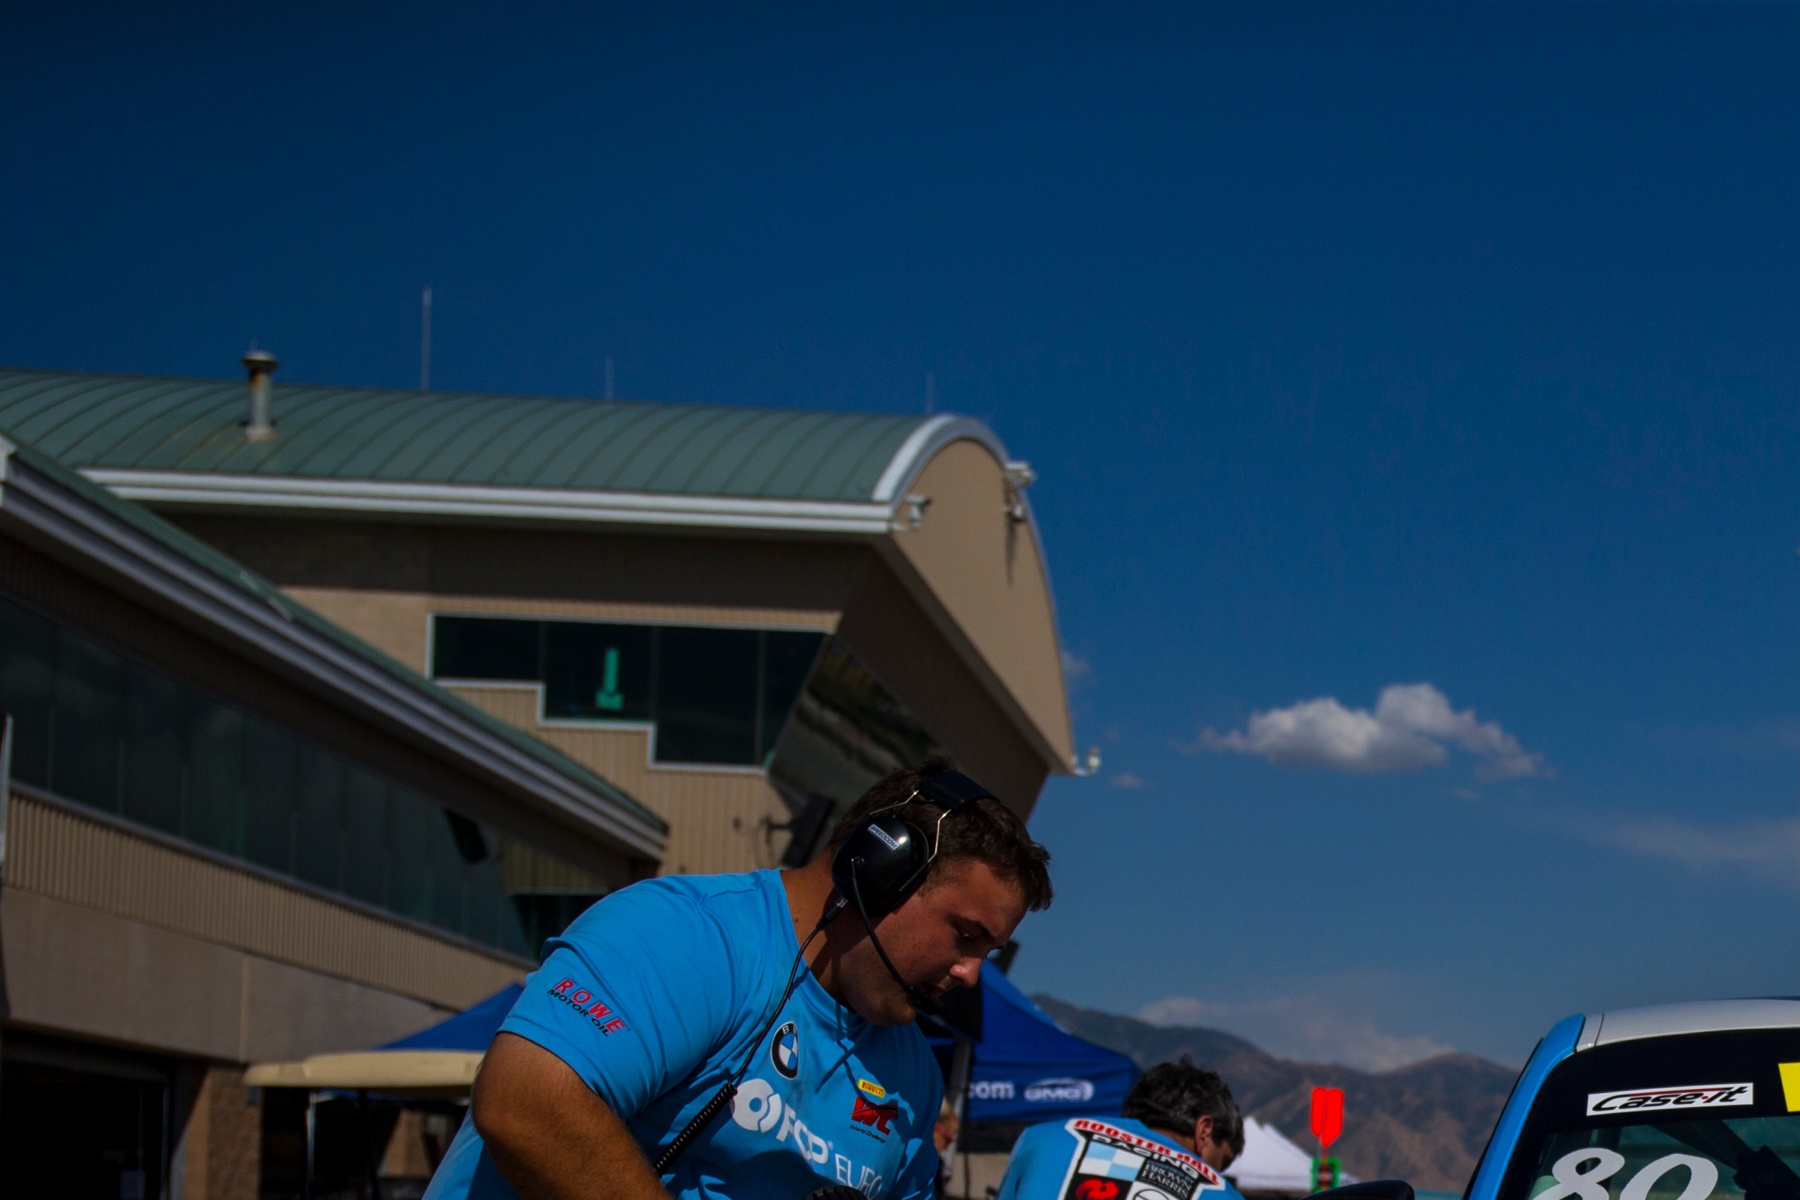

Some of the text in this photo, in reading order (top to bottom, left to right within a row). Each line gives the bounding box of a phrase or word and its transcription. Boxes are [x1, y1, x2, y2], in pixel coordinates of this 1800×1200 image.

[548, 989, 609, 1037] MOTOR OIL
[553, 978, 627, 1035] ROWE
[776, 1103, 829, 1165] FCP
[1074, 1118, 1220, 1185] ROOSTER HALL
[1092, 1134, 1200, 1179] RACING
[1141, 1170, 1189, 1199] HARRIS
[1145, 1163, 1192, 1191] BROWN
